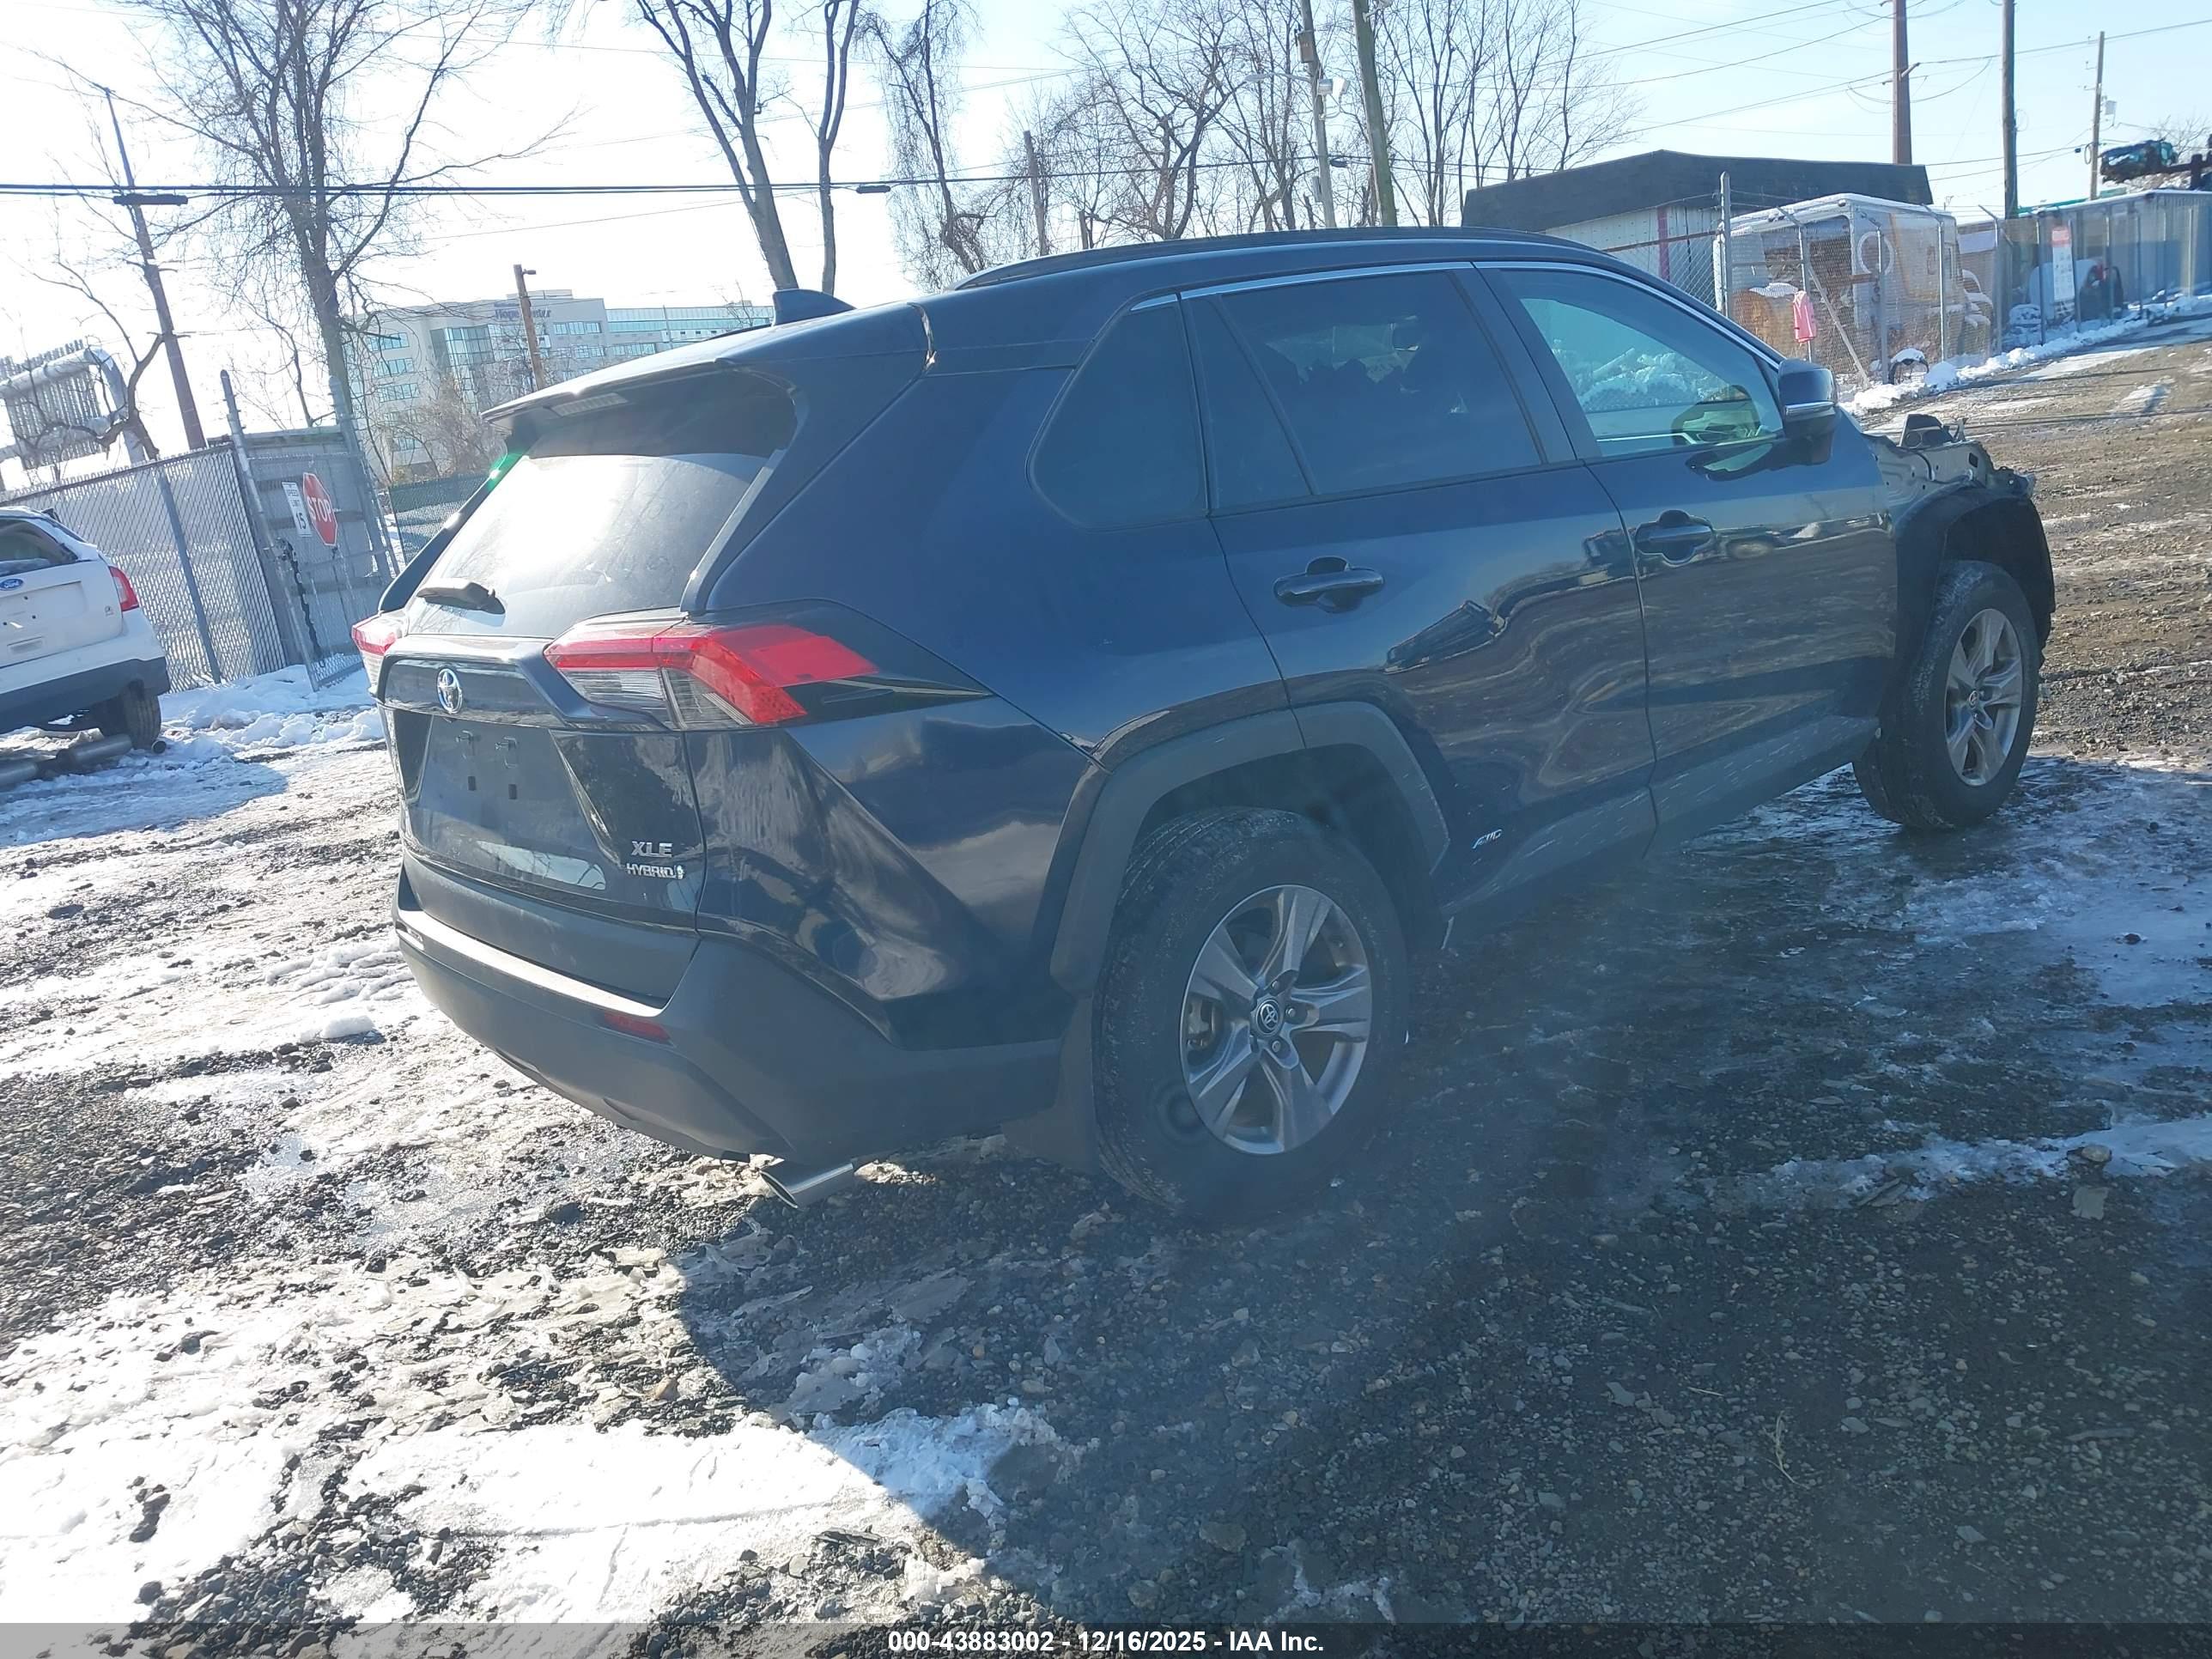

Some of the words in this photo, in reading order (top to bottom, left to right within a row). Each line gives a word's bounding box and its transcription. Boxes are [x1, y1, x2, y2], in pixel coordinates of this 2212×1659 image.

[307, 495, 333, 523] STOP
[295, 511, 307, 530] 15
[631, 841, 673, 858] XLE
[626, 862, 677, 879] HYBRID
